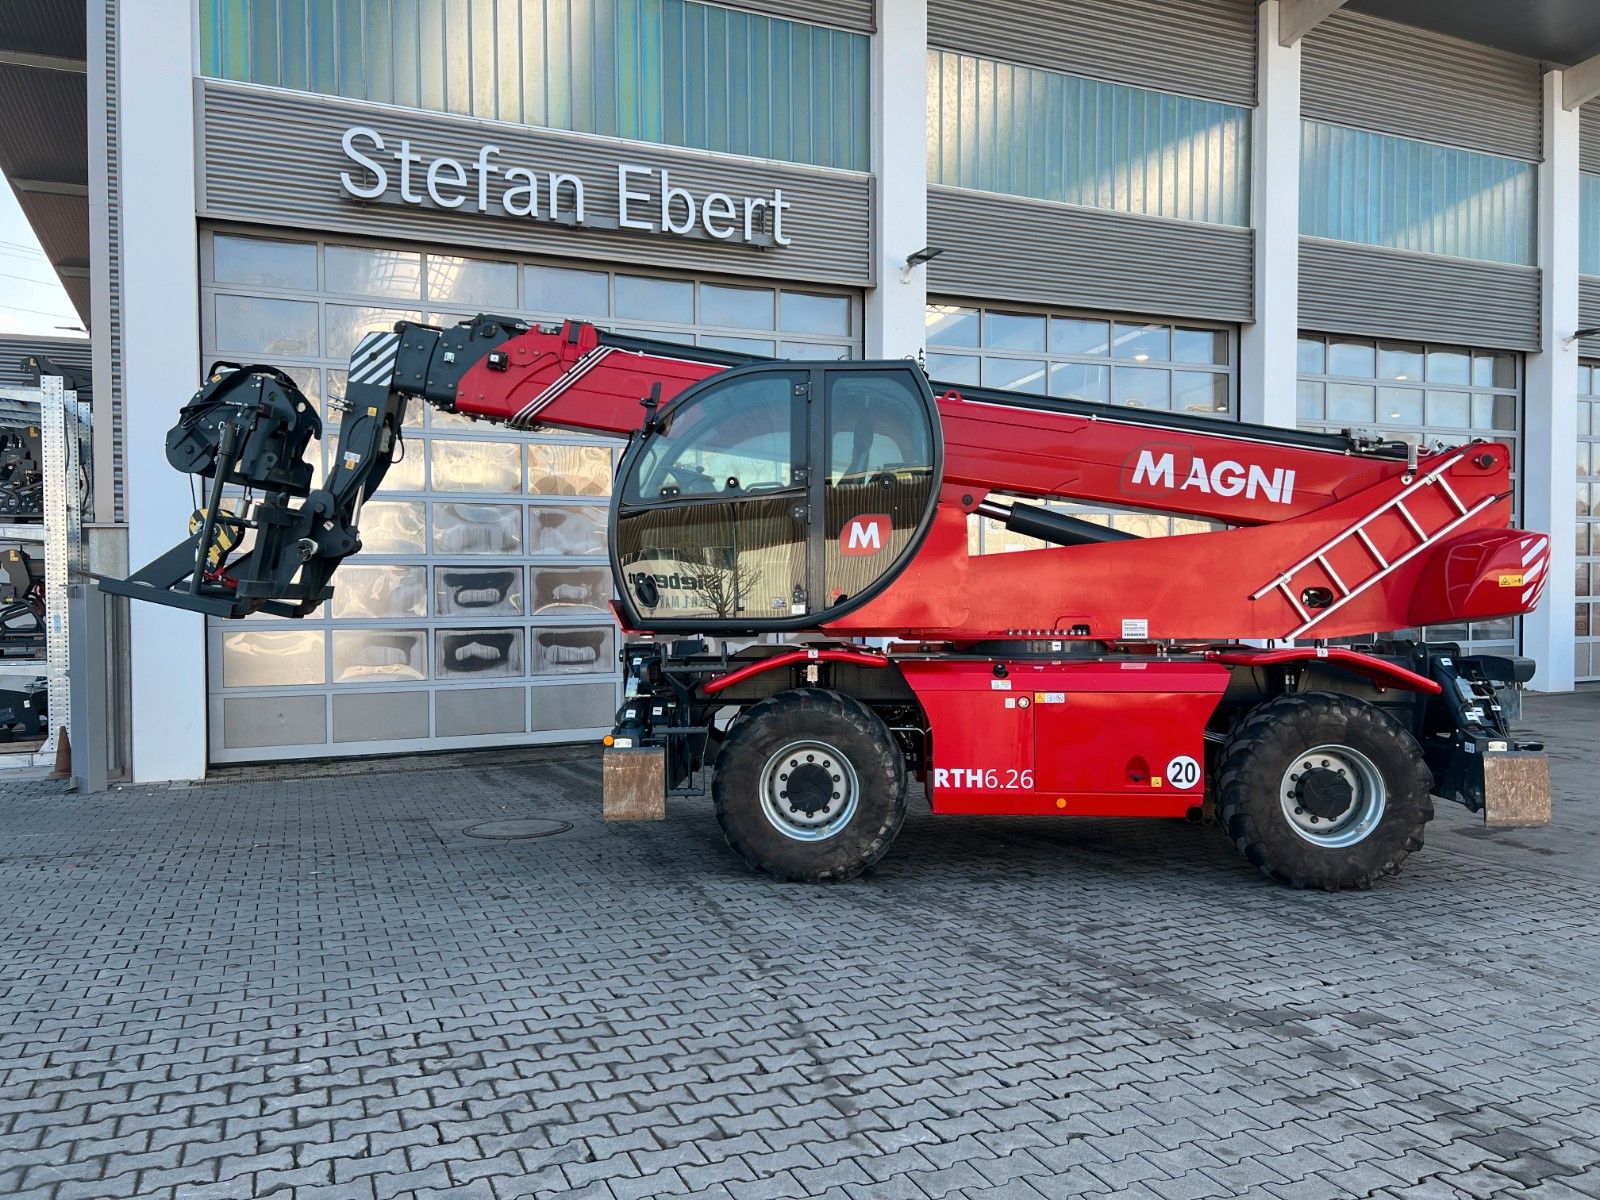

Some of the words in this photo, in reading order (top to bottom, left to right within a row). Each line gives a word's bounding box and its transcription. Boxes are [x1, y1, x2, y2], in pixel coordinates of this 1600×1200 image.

[340, 126, 584, 223] Stefan
[618, 163, 791, 246] Ebert
[1131, 449, 1296, 505] MAGNI
[848, 521, 881, 549] M
[933, 767, 1034, 789] RTH6.26
[1171, 761, 1197, 783] 20
